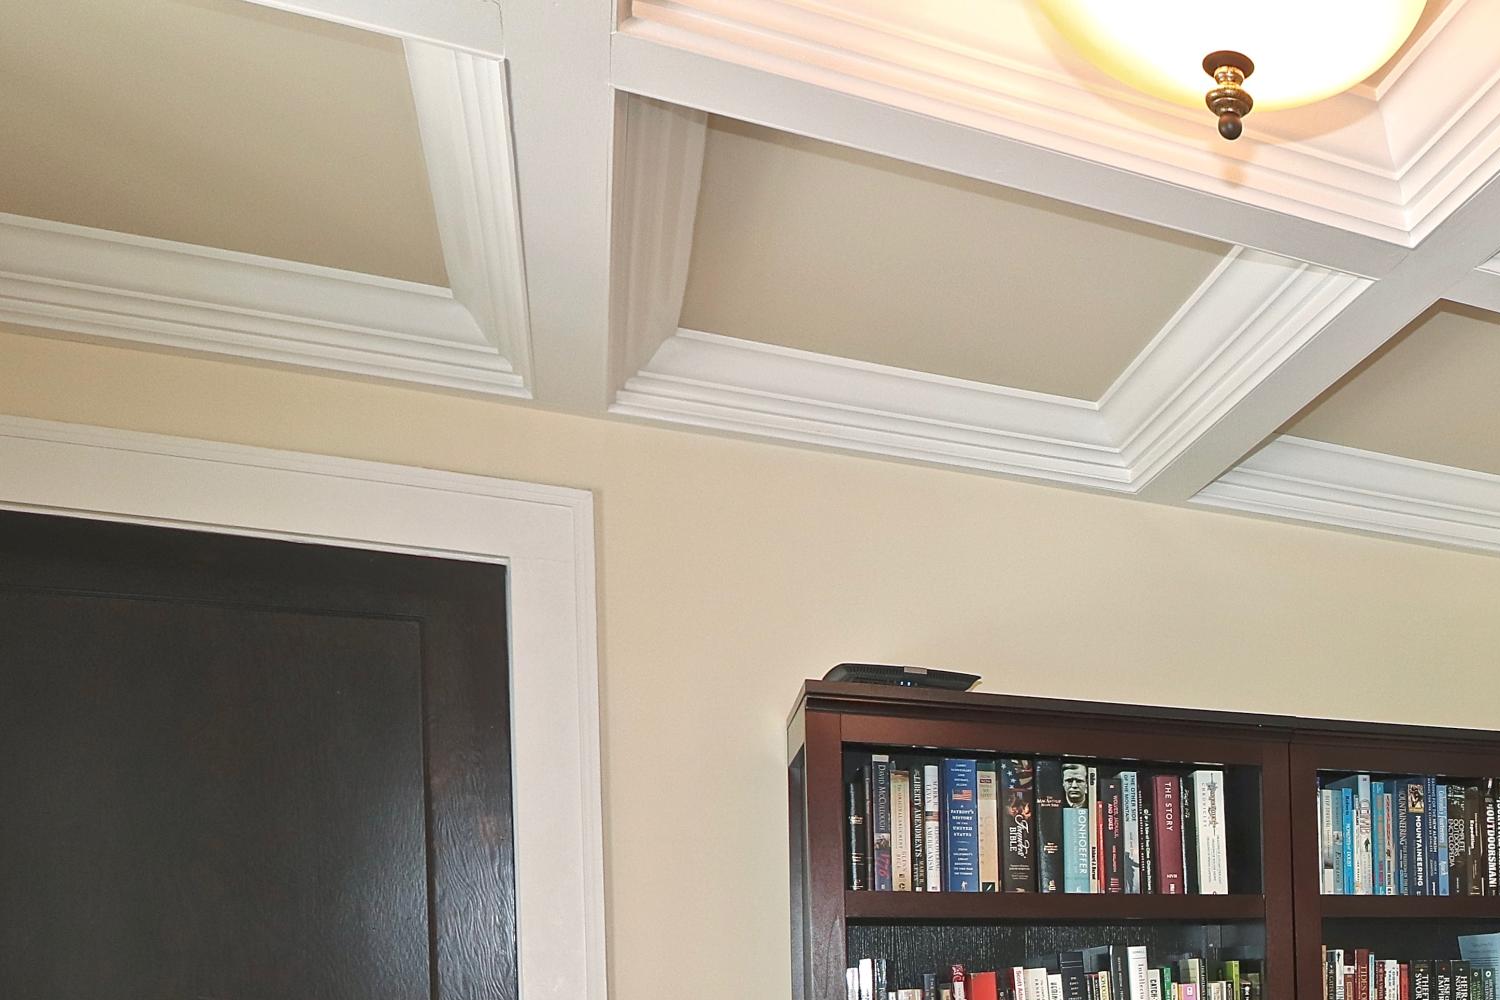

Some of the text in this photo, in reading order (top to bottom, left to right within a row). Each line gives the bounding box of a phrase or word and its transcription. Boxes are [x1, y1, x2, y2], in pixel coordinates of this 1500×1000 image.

[913, 776, 922, 857] LIBERTY AMENDMENTS
[1009, 827, 1017, 851] BIBLE
[1078, 809, 1087, 874] BONHOEFFER
[1415, 816, 1423, 886] MOUNTAINEERING
[878, 852, 890, 879] 1776
[1460, 976, 1468, 998] HEIR
